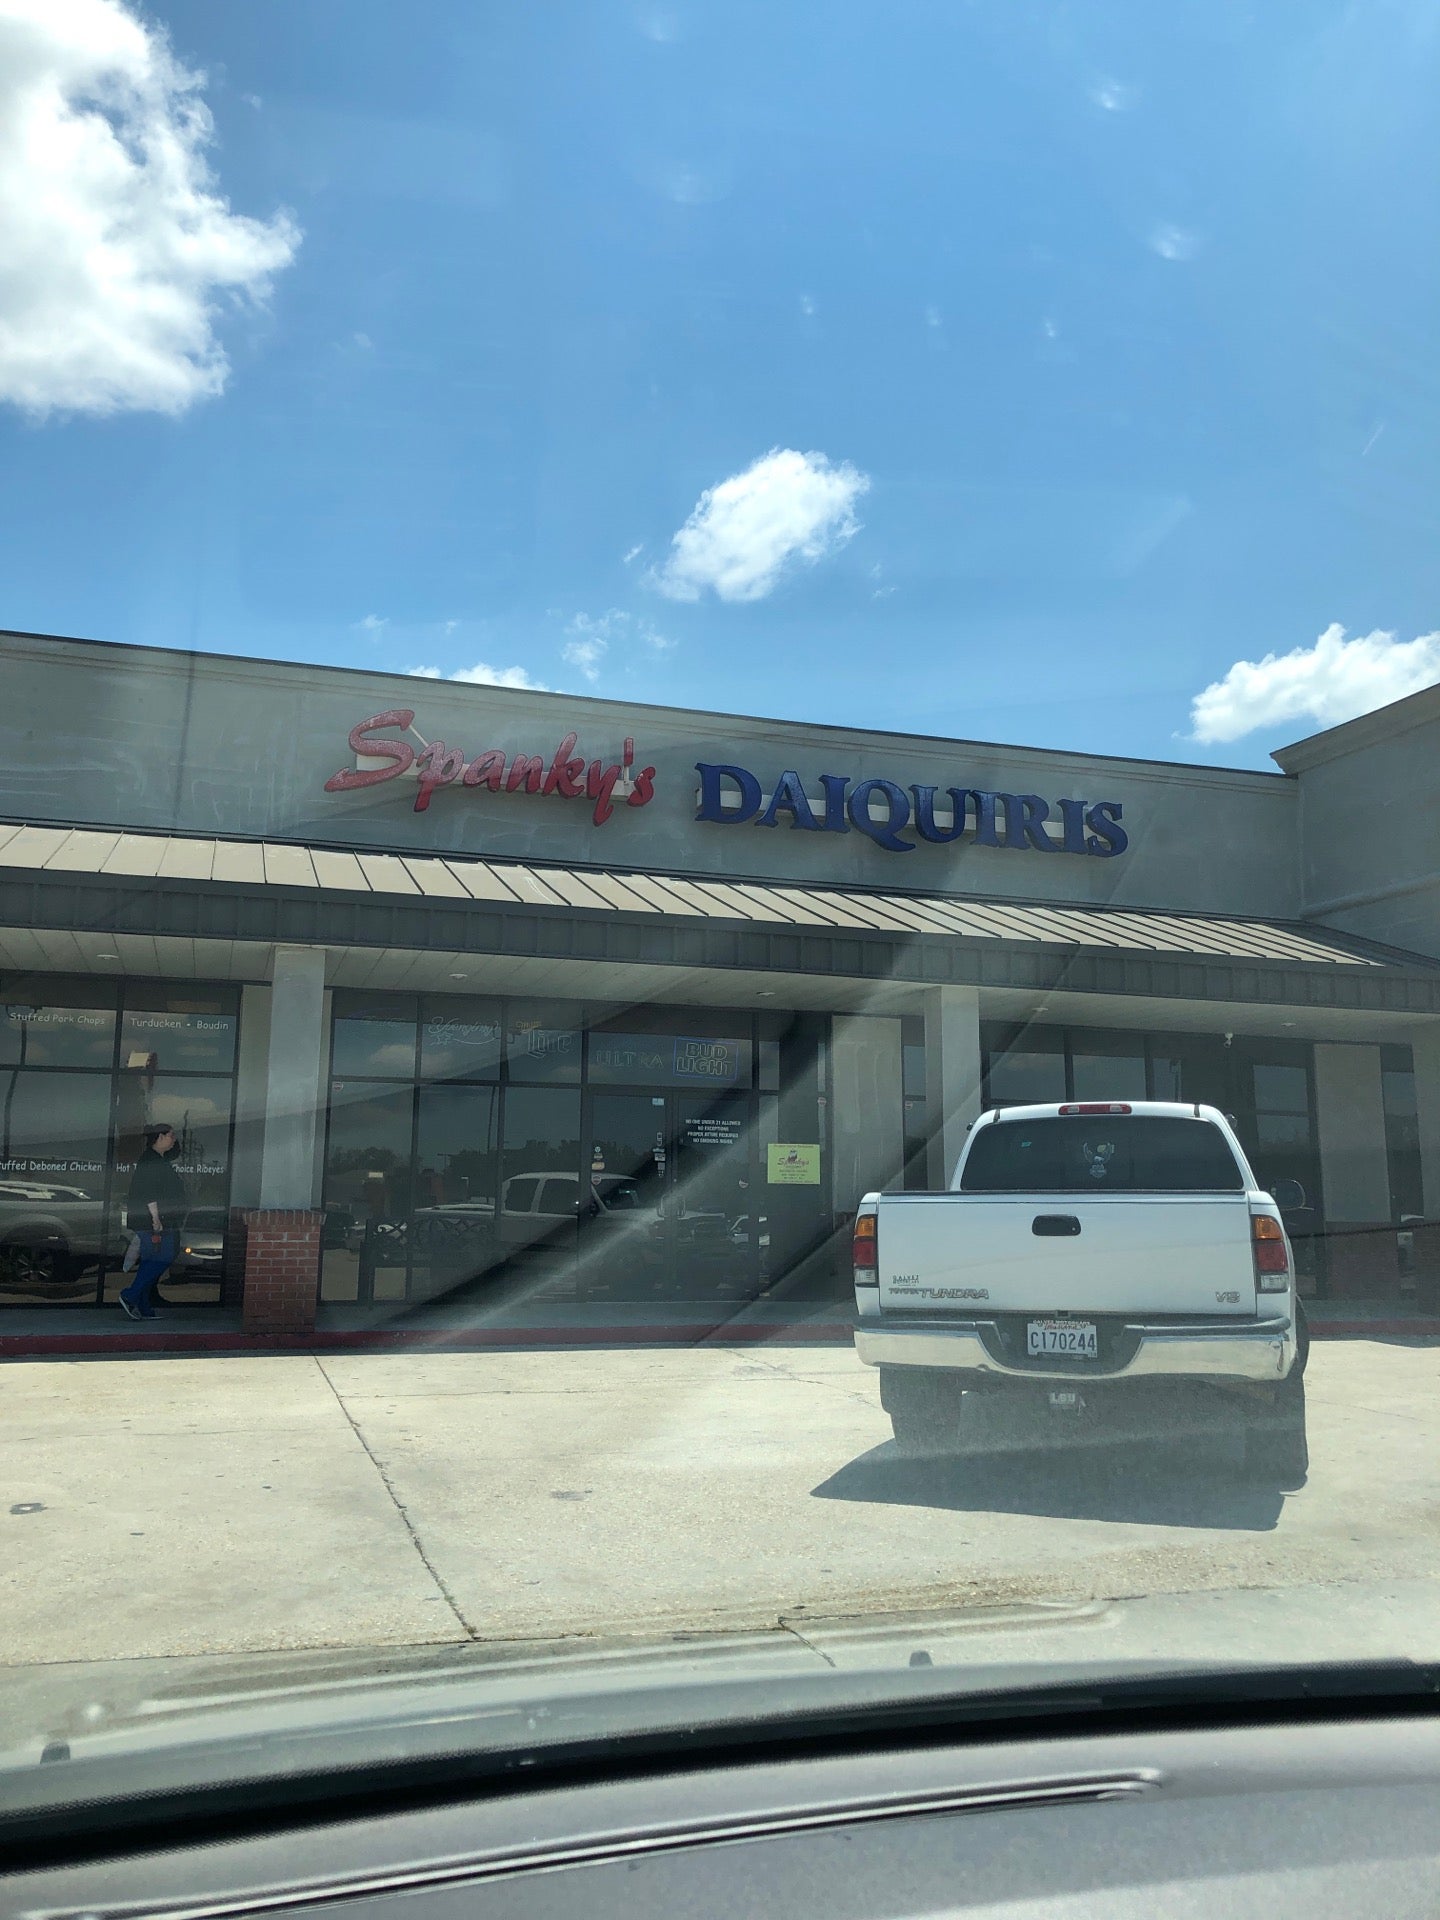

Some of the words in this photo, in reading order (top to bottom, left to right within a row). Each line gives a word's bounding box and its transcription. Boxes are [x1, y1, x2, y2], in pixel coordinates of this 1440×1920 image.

[324, 709, 656, 827] Spanky's
[694, 762, 1129, 858] DAIQUIRIS
[9, 1012, 50, 1023] Stuffed
[52, 1014, 74, 1023] Pork
[77, 1015, 105, 1026] Chops
[130, 1017, 182, 1029] Turducken
[196, 1020, 229, 1030] Boudin
[686, 1042, 728, 1060] BUD
[596, 1050, 664, 1070] ULTRA
[676, 1057, 734, 1076] LIGHT
[30, 1161, 67, 1171] Deboned
[70, 1161, 102, 1172] Chicken
[116, 1163, 130, 1173] Hot
[196, 1164, 225, 1176] Ribeyes
[921, 1288, 990, 1299] TUNDRA
[1031, 1332, 1095, 1351] C170244
